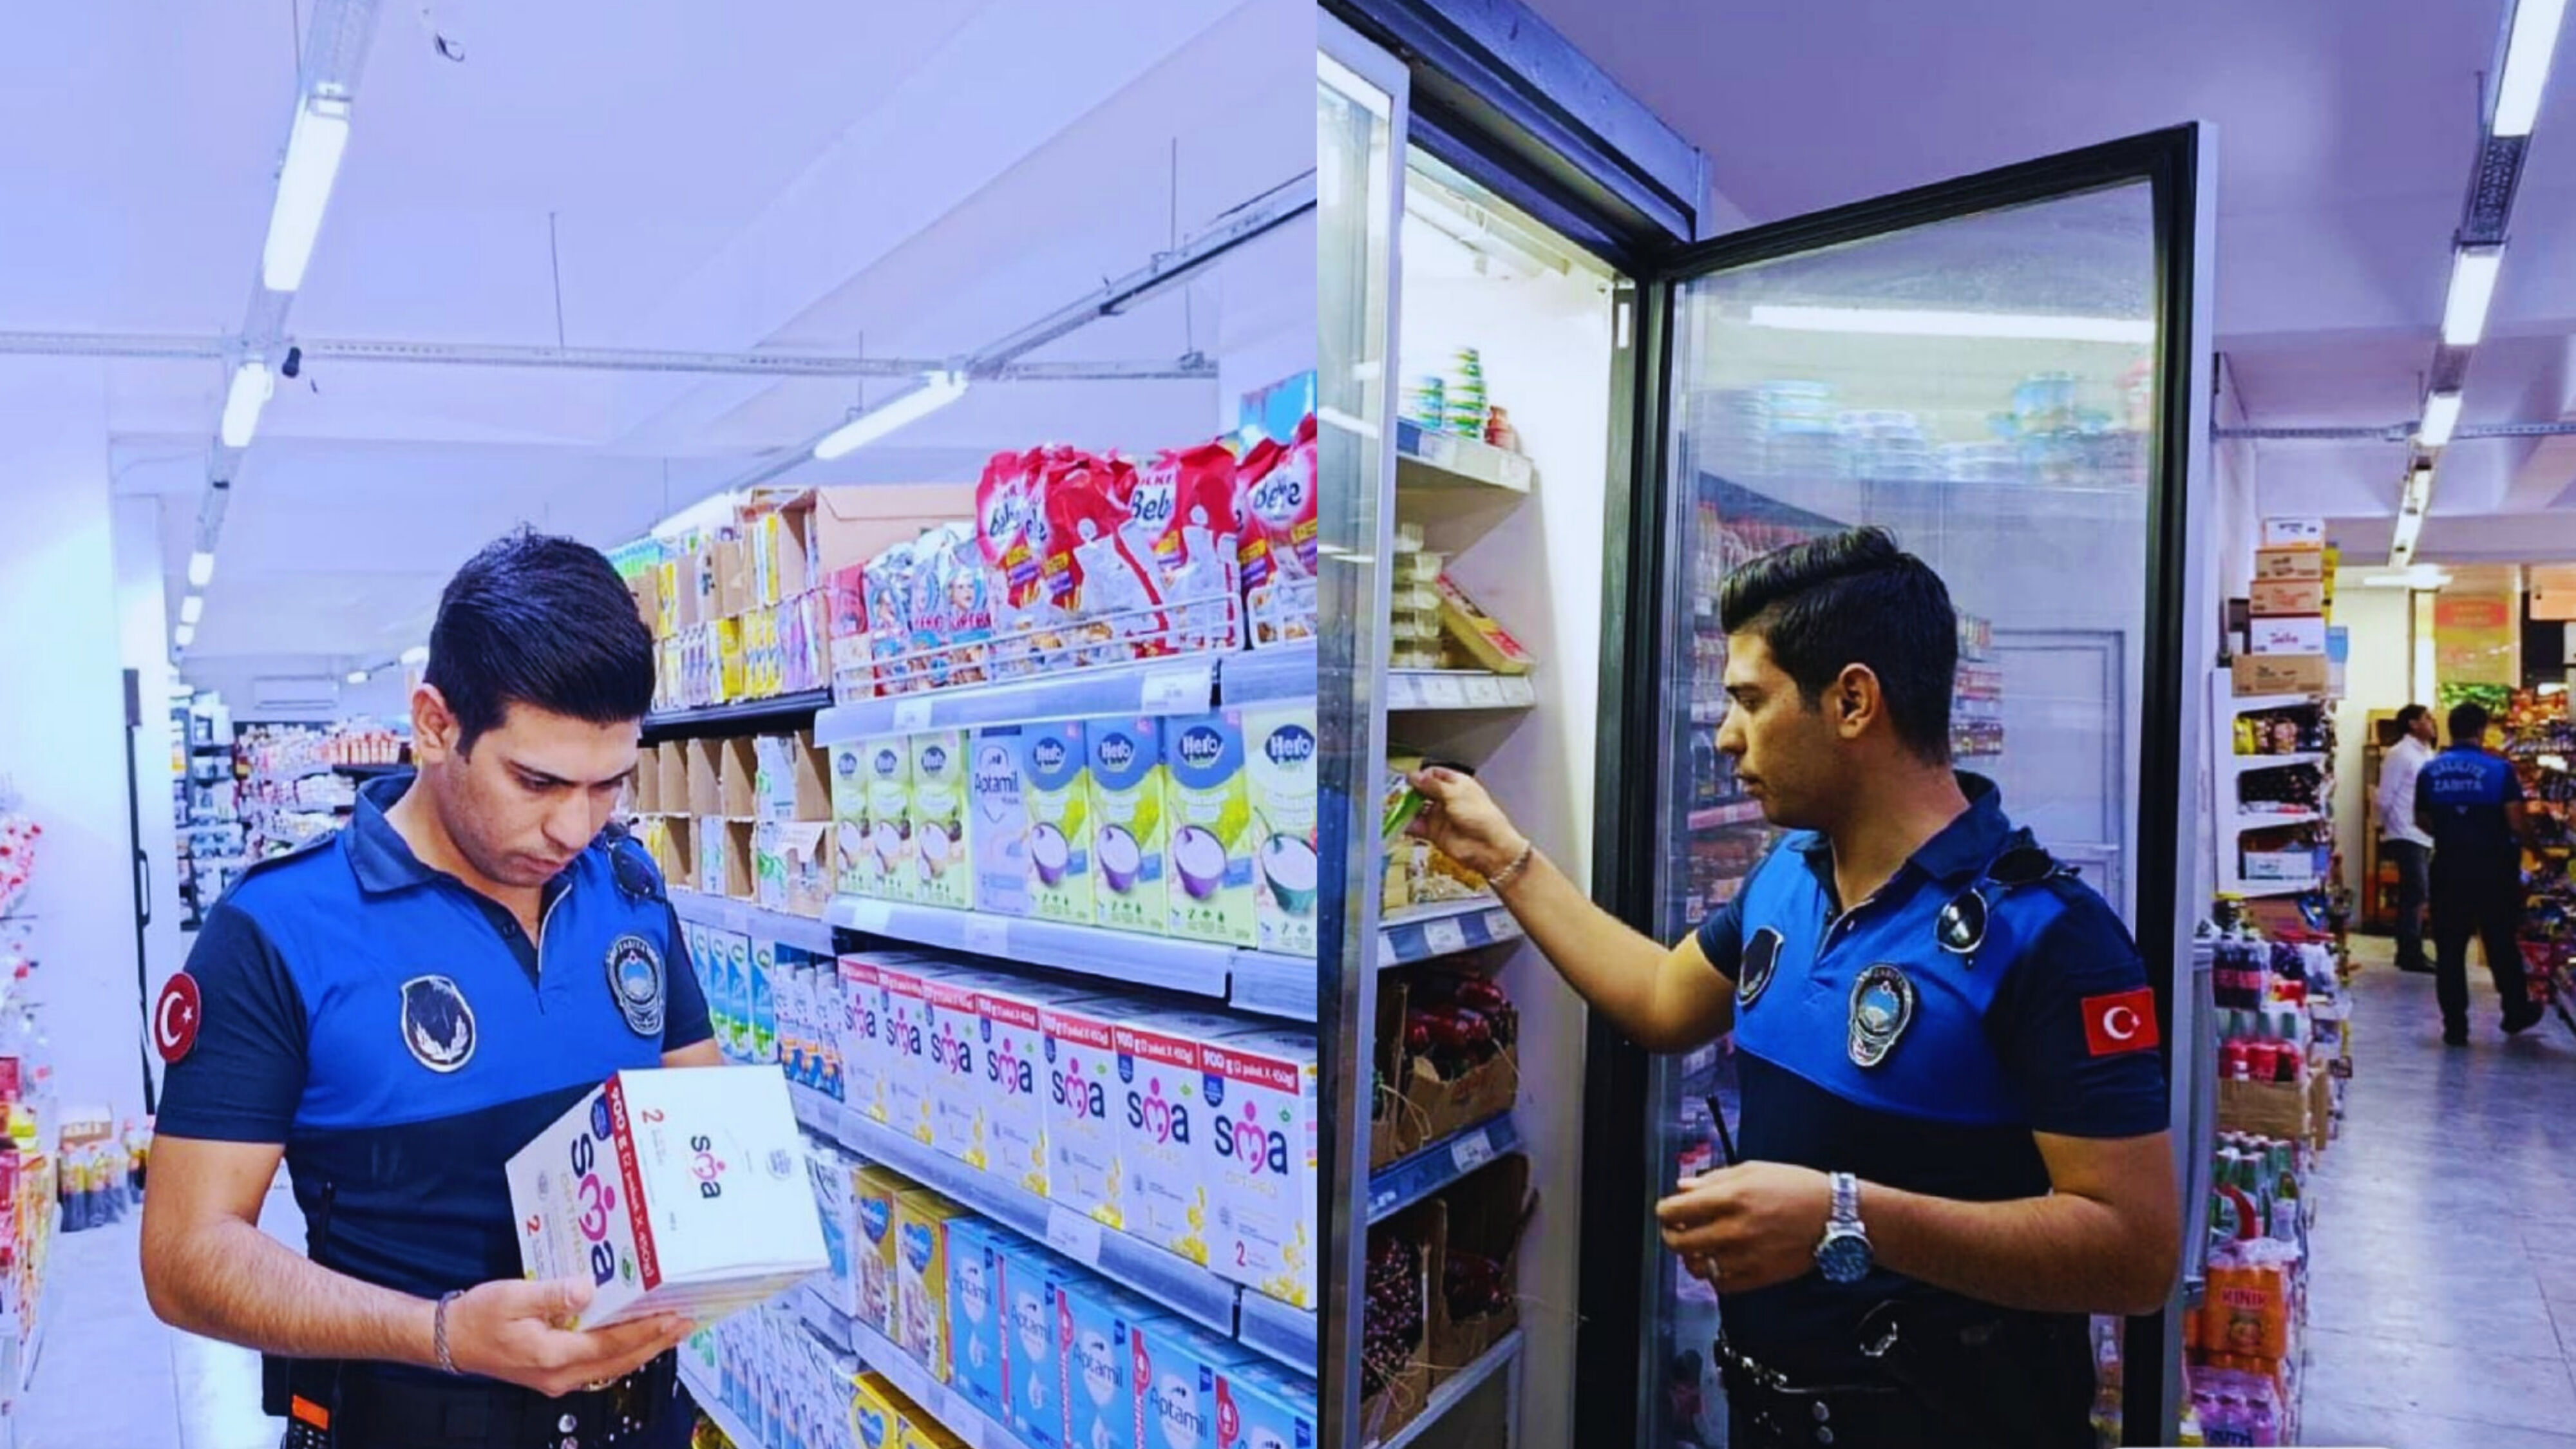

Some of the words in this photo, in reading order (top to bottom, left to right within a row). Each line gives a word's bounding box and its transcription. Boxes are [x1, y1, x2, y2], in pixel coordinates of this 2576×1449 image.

[1102, 741, 1132, 759] Hero
[1183, 735, 1218, 757] Hero
[1270, 734, 1312, 757] Hero
[974, 770, 1020, 793] Aptamil
[931, 1021, 972, 1074] sma
[987, 1038, 1033, 1095] sma
[1203, 1049, 1224, 1068] 900
[611, 1086, 626, 1131] 900
[1052, 1057, 1105, 1119] sma
[1127, 1077, 1190, 1143] sma
[641, 1108, 665, 1124] 2
[1214, 1100, 1288, 1175] sma
[618, 1134, 628, 1151] g
[690, 1135, 726, 1198] sma
[526, 1214, 540, 1237] 2
[571, 1133, 616, 1287] sma
[1236, 1240, 1246, 1267] 2
[1073, 1342, 1123, 1388] Aptamil
[1150, 1386, 1208, 1439] Aptamil
